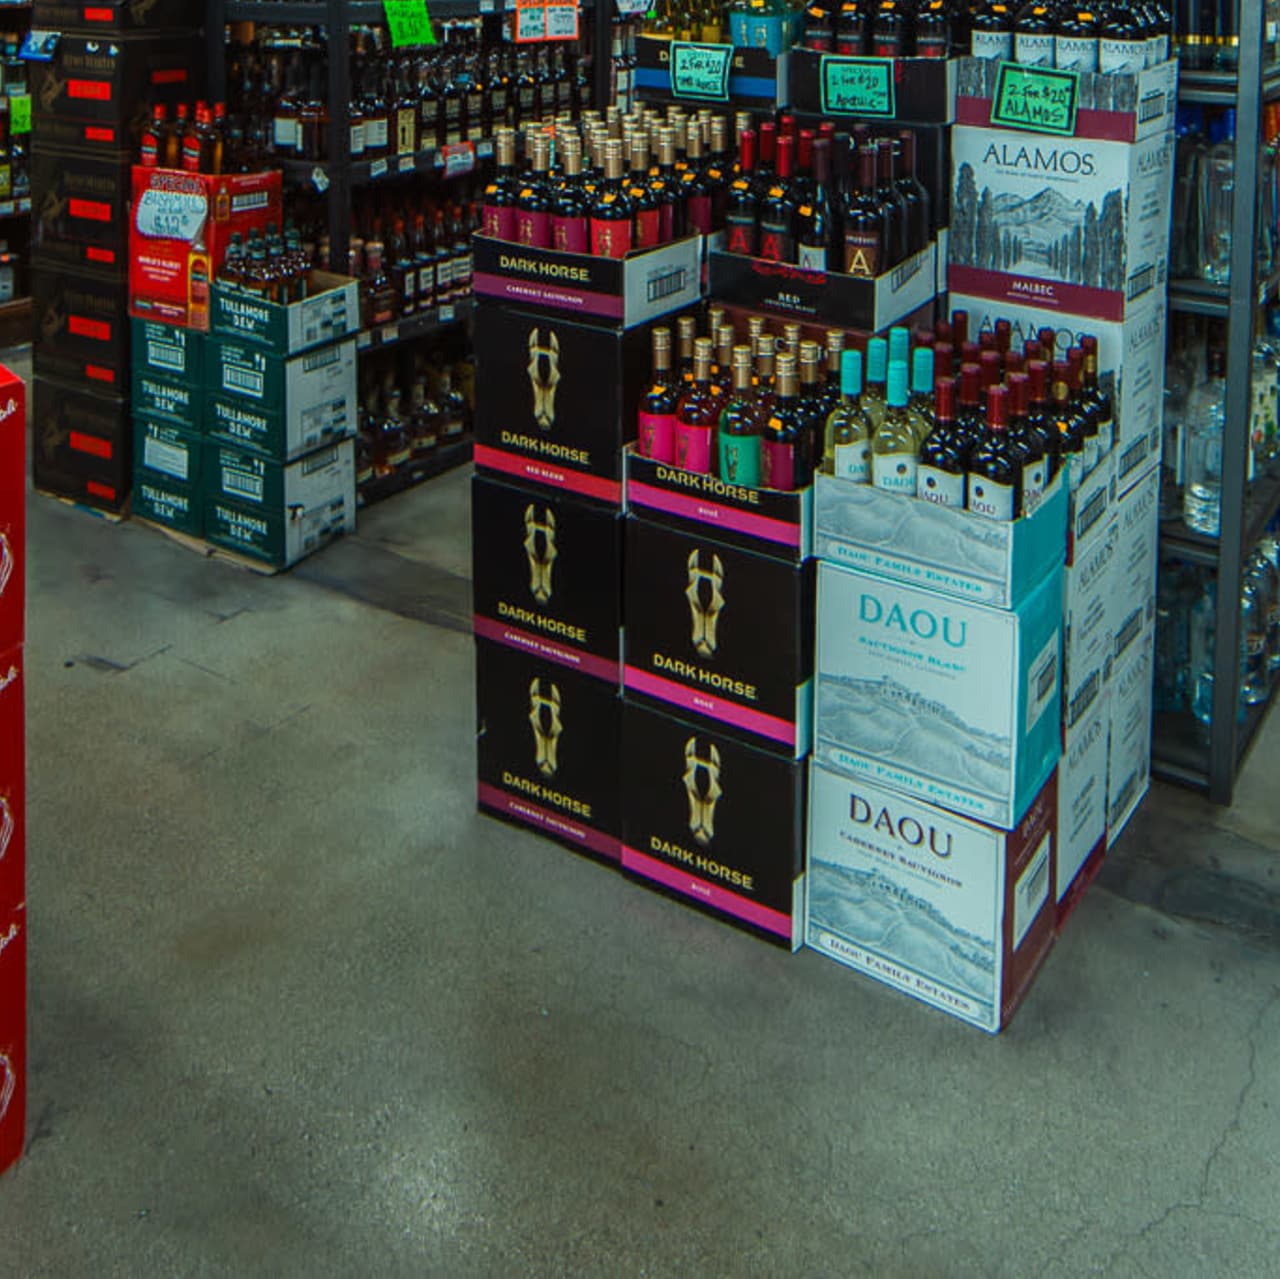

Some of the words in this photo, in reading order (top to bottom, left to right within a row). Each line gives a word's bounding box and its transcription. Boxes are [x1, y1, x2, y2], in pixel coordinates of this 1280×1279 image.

[1005, 99, 1064, 124] ALAMOS
[983, 142, 1094, 176] ALAMOS
[150, 173, 202, 195] SPECIAL
[500, 255, 537, 274] DARK
[538, 261, 589, 282] HORSE
[849, 249, 871, 274] A
[778, 292, 800, 304] RED
[1012, 281, 1054, 296] MALBEC
[220, 298, 269, 322] TULLAMORE
[142, 380, 189, 405] TULLAMORE
[216, 404, 267, 432] TULLAMORE
[501, 430, 537, 453] DARK
[538, 440, 591, 465] HORSE
[142, 484, 188, 511] TULLAMORE
[656, 466, 699, 489] DARK
[701, 477, 759, 505] HORSE
[216, 506, 267, 536] TULLAMORE
[874, 554, 922, 577] FAMILY
[925, 565, 983, 594] ESTATES
[497, 601, 536, 627] DARK
[538, 615, 587, 643] HORSE
[859, 593, 967, 649] DAOU
[653, 652, 698, 680] DARK
[699, 669, 757, 699] HORSE
[503, 771, 541, 798] DARK
[542, 788, 592, 818] HORSE
[849, 793, 953, 859] DAOU
[650, 835, 695, 866] DARK
[696, 855, 754, 890] HORSE
[839, 831, 896, 860] CABERNET
[898, 854, 963, 888] SAUVIGNON
[865, 955, 912, 983] FAMILY
[916, 977, 972, 1011] ESTATES
